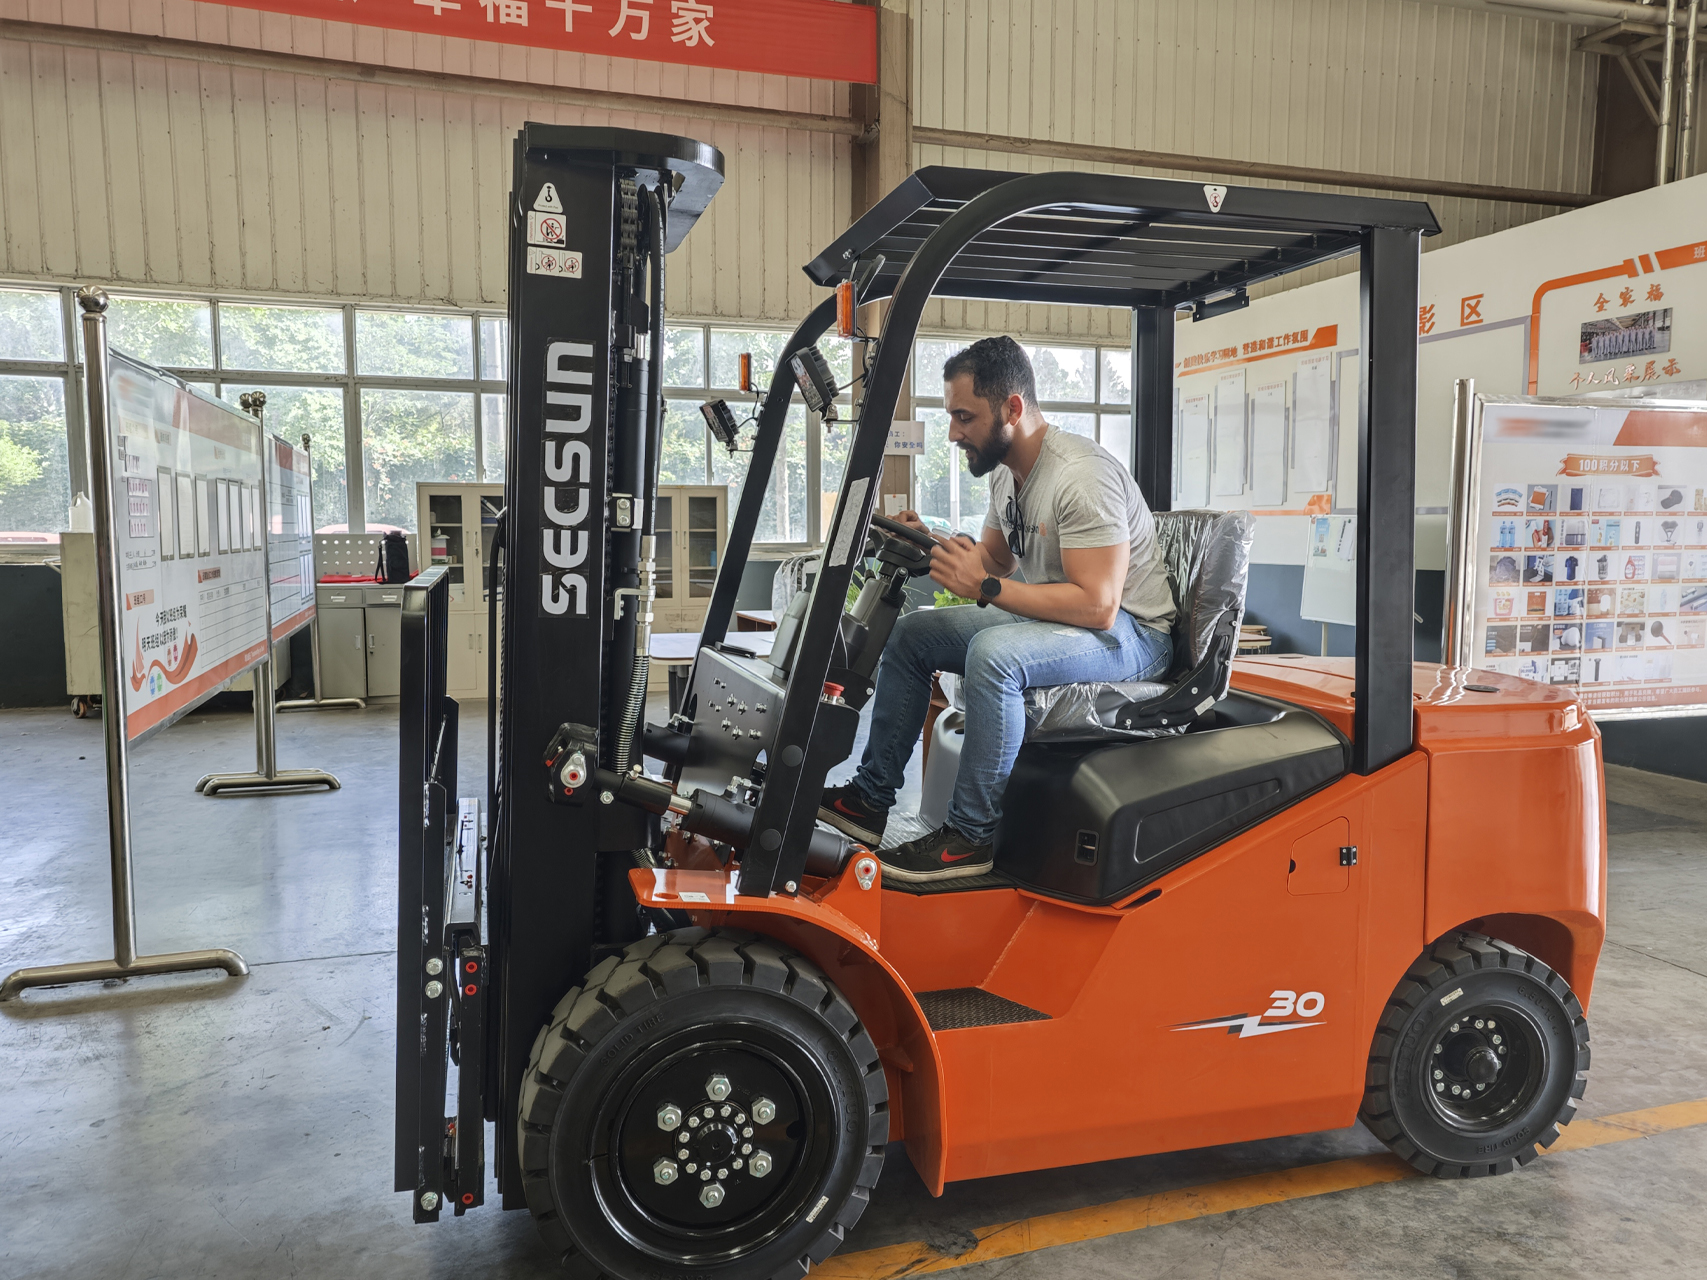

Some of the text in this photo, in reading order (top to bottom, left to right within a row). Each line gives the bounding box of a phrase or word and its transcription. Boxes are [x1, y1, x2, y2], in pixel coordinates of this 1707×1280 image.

[1593, 283, 1665, 313] 全家福
[1569, 358, 1682, 391] 个人风采展示
[541, 341, 594, 615] SECSUN
[1579, 459, 1640, 472] 100积分以下
[1263, 990, 1325, 1017] 30
